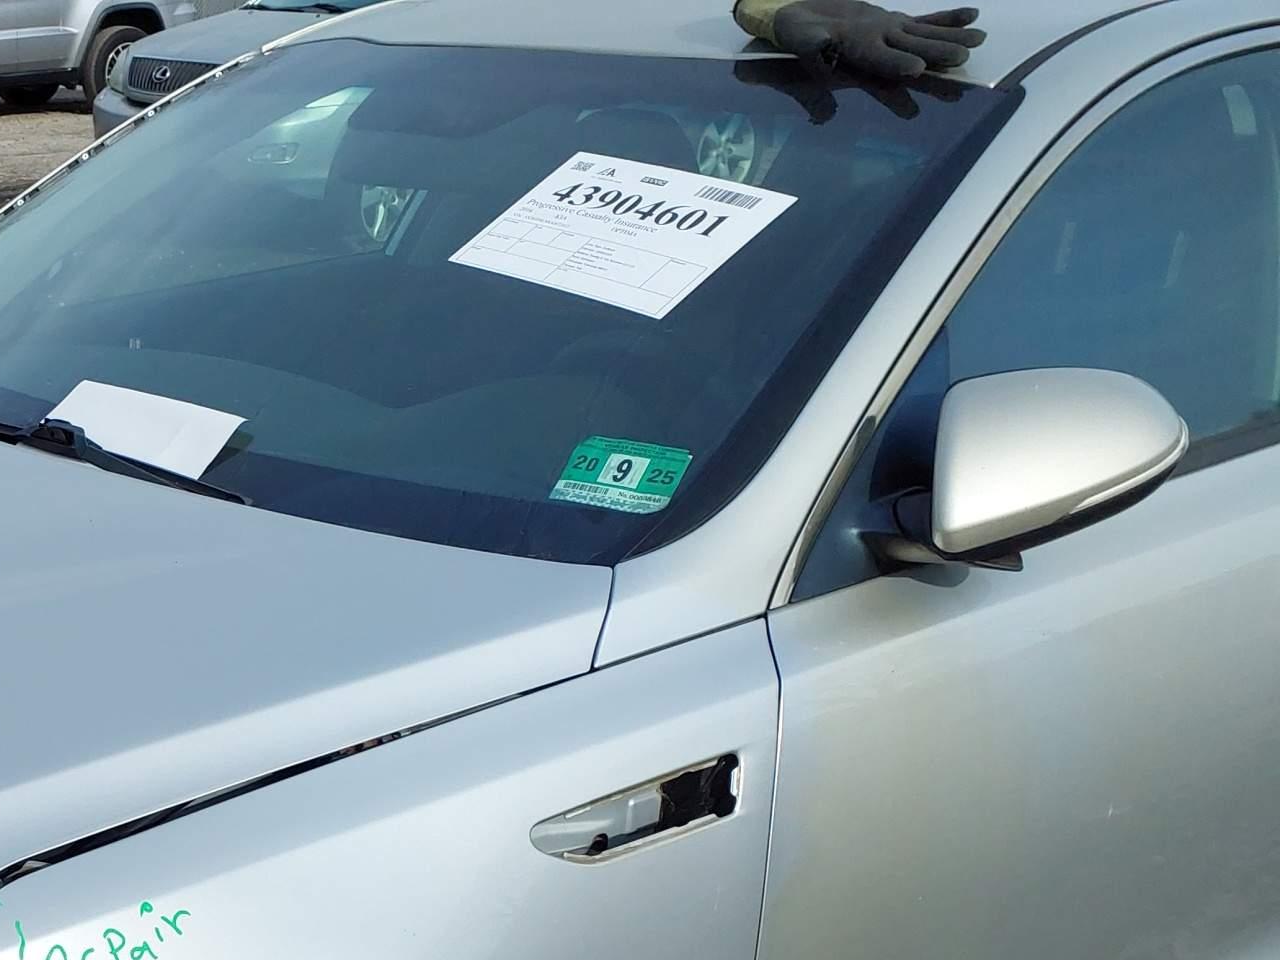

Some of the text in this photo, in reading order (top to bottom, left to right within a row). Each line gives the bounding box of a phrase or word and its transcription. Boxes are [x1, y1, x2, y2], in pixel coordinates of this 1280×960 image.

[527, 198, 576, 214] Progressive
[576, 208, 613, 224] Casualty
[614, 217, 658, 233] Insurance
[552, 182, 730, 238] 43904601
[572, 454, 677, 485] 20 9 25
